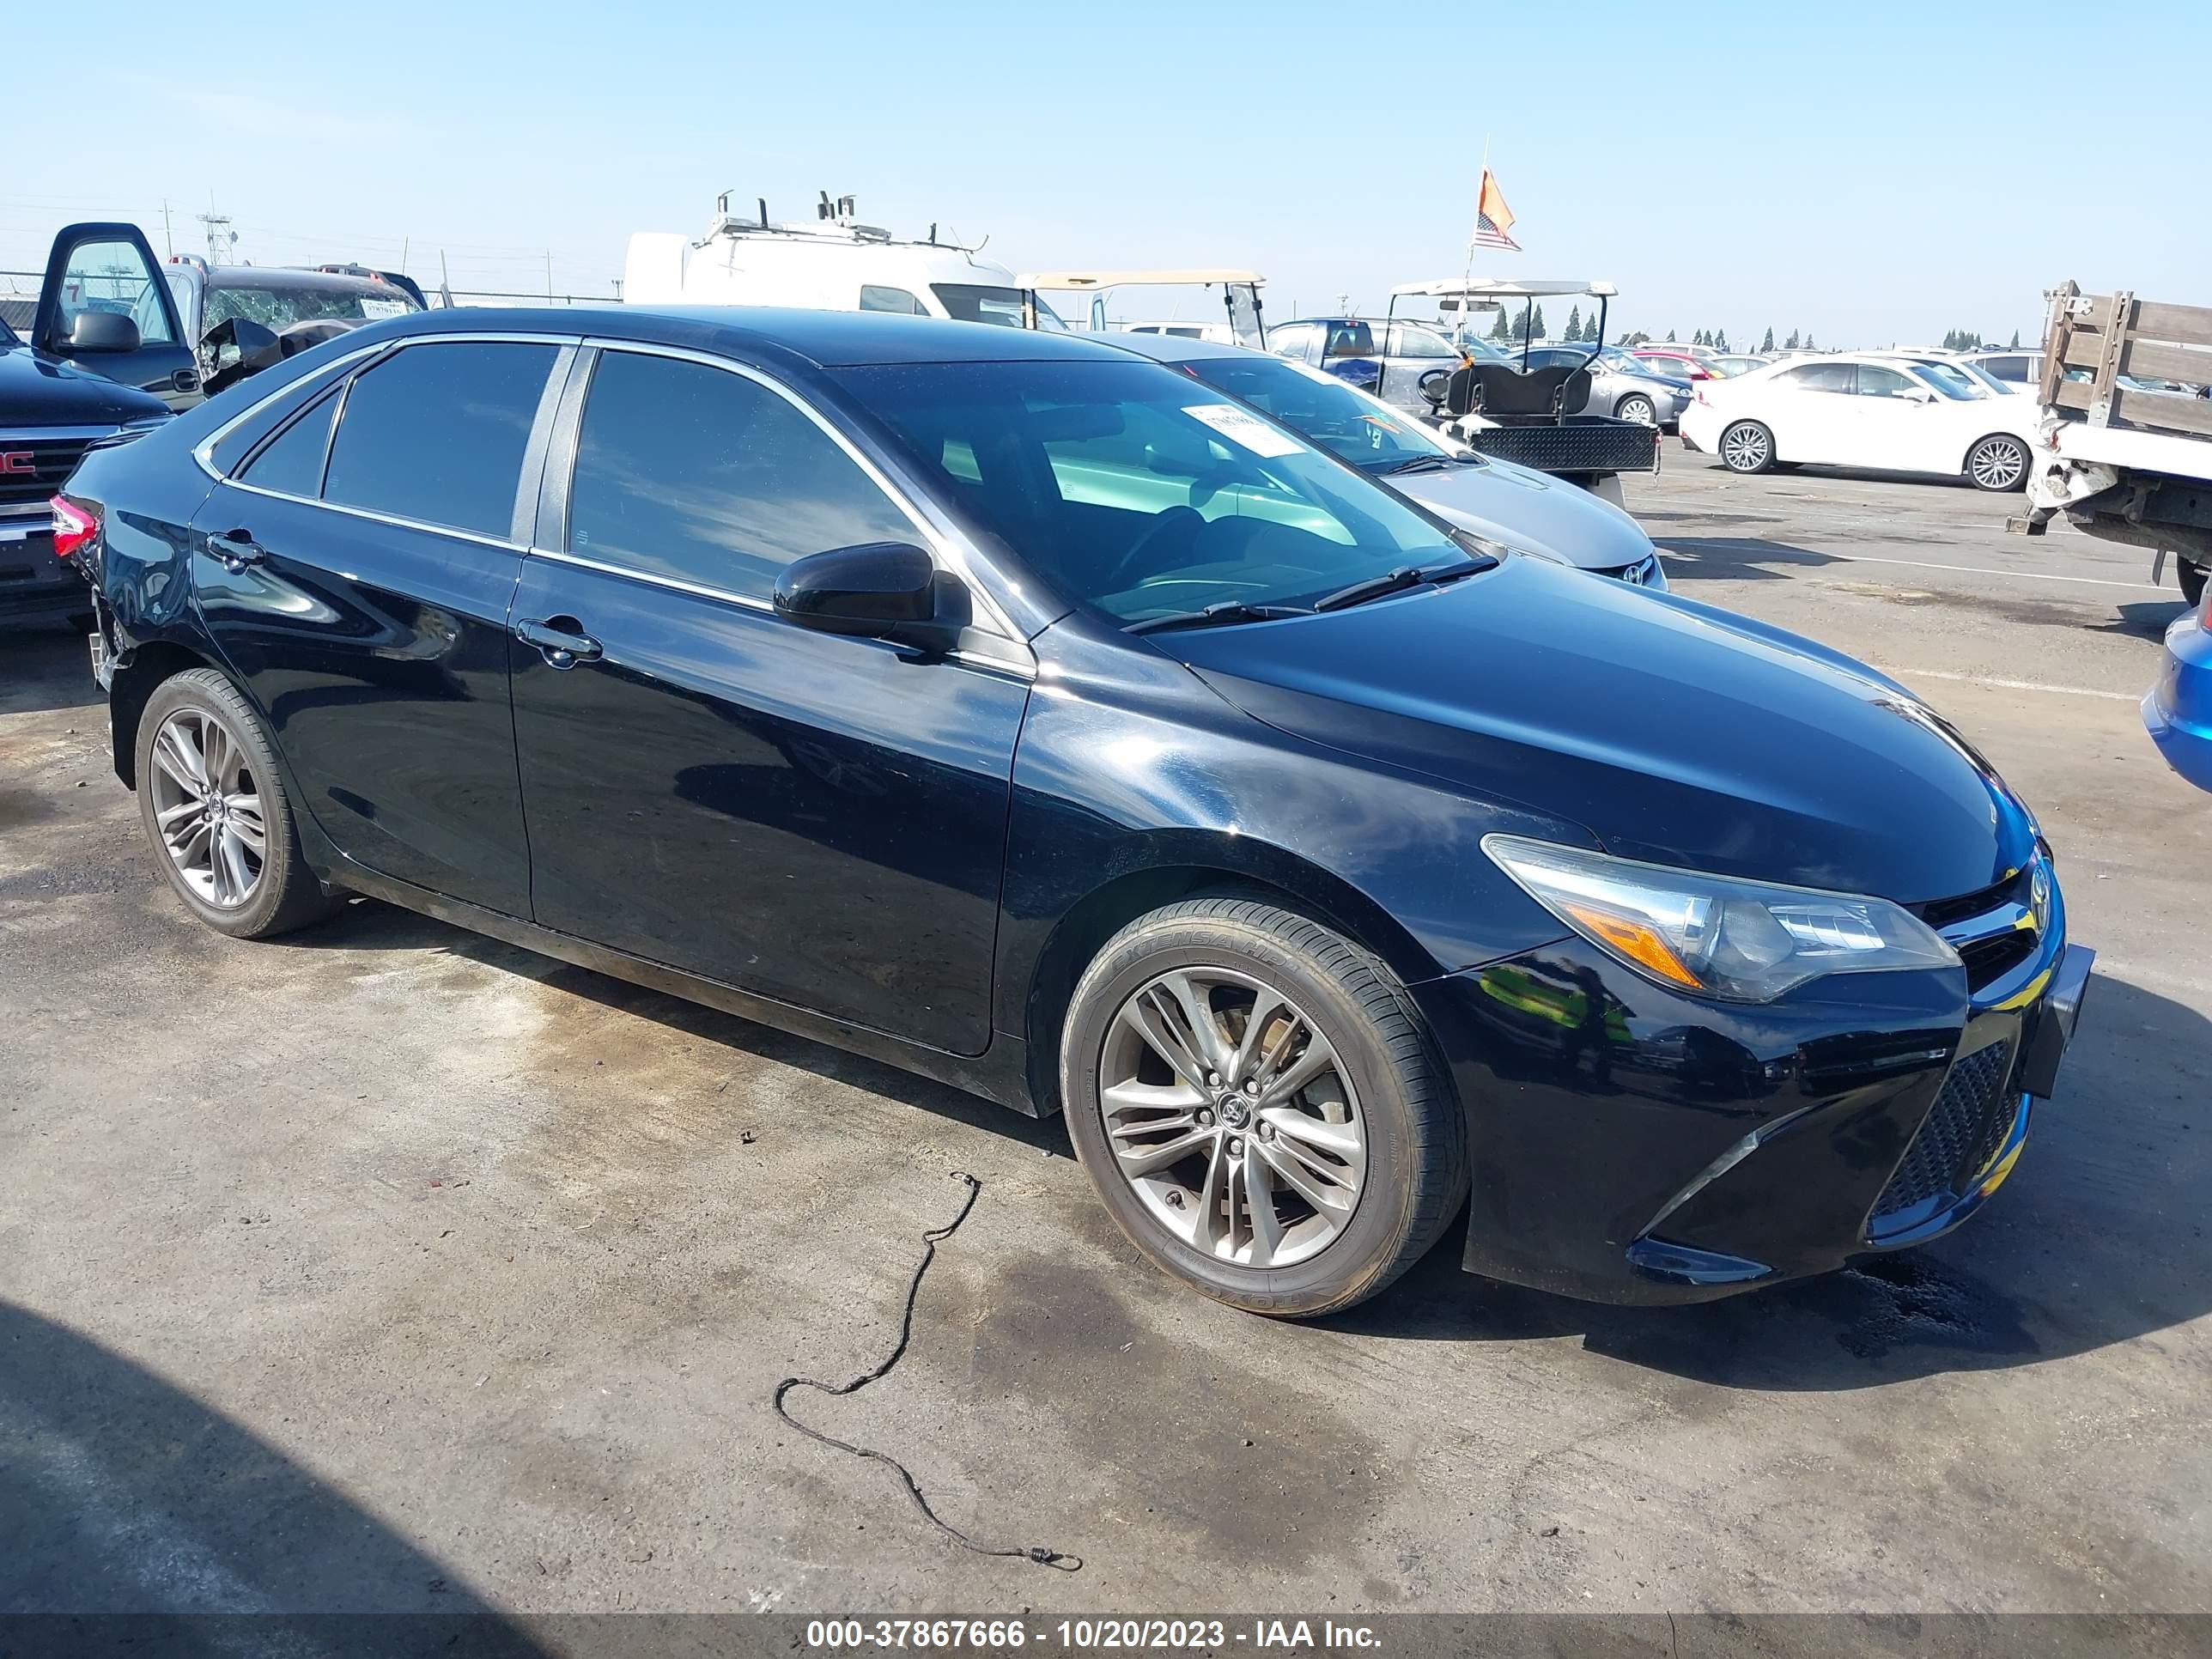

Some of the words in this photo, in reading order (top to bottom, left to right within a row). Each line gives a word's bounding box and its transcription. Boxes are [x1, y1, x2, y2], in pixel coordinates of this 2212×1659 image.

[66, 285, 79, 303] 7
[0, 452, 35, 473] C
[1111, 929, 1234, 970] EXTENSA
[1242, 940, 1287, 967] HP
[1194, 1279, 1304, 1310] TOYO
